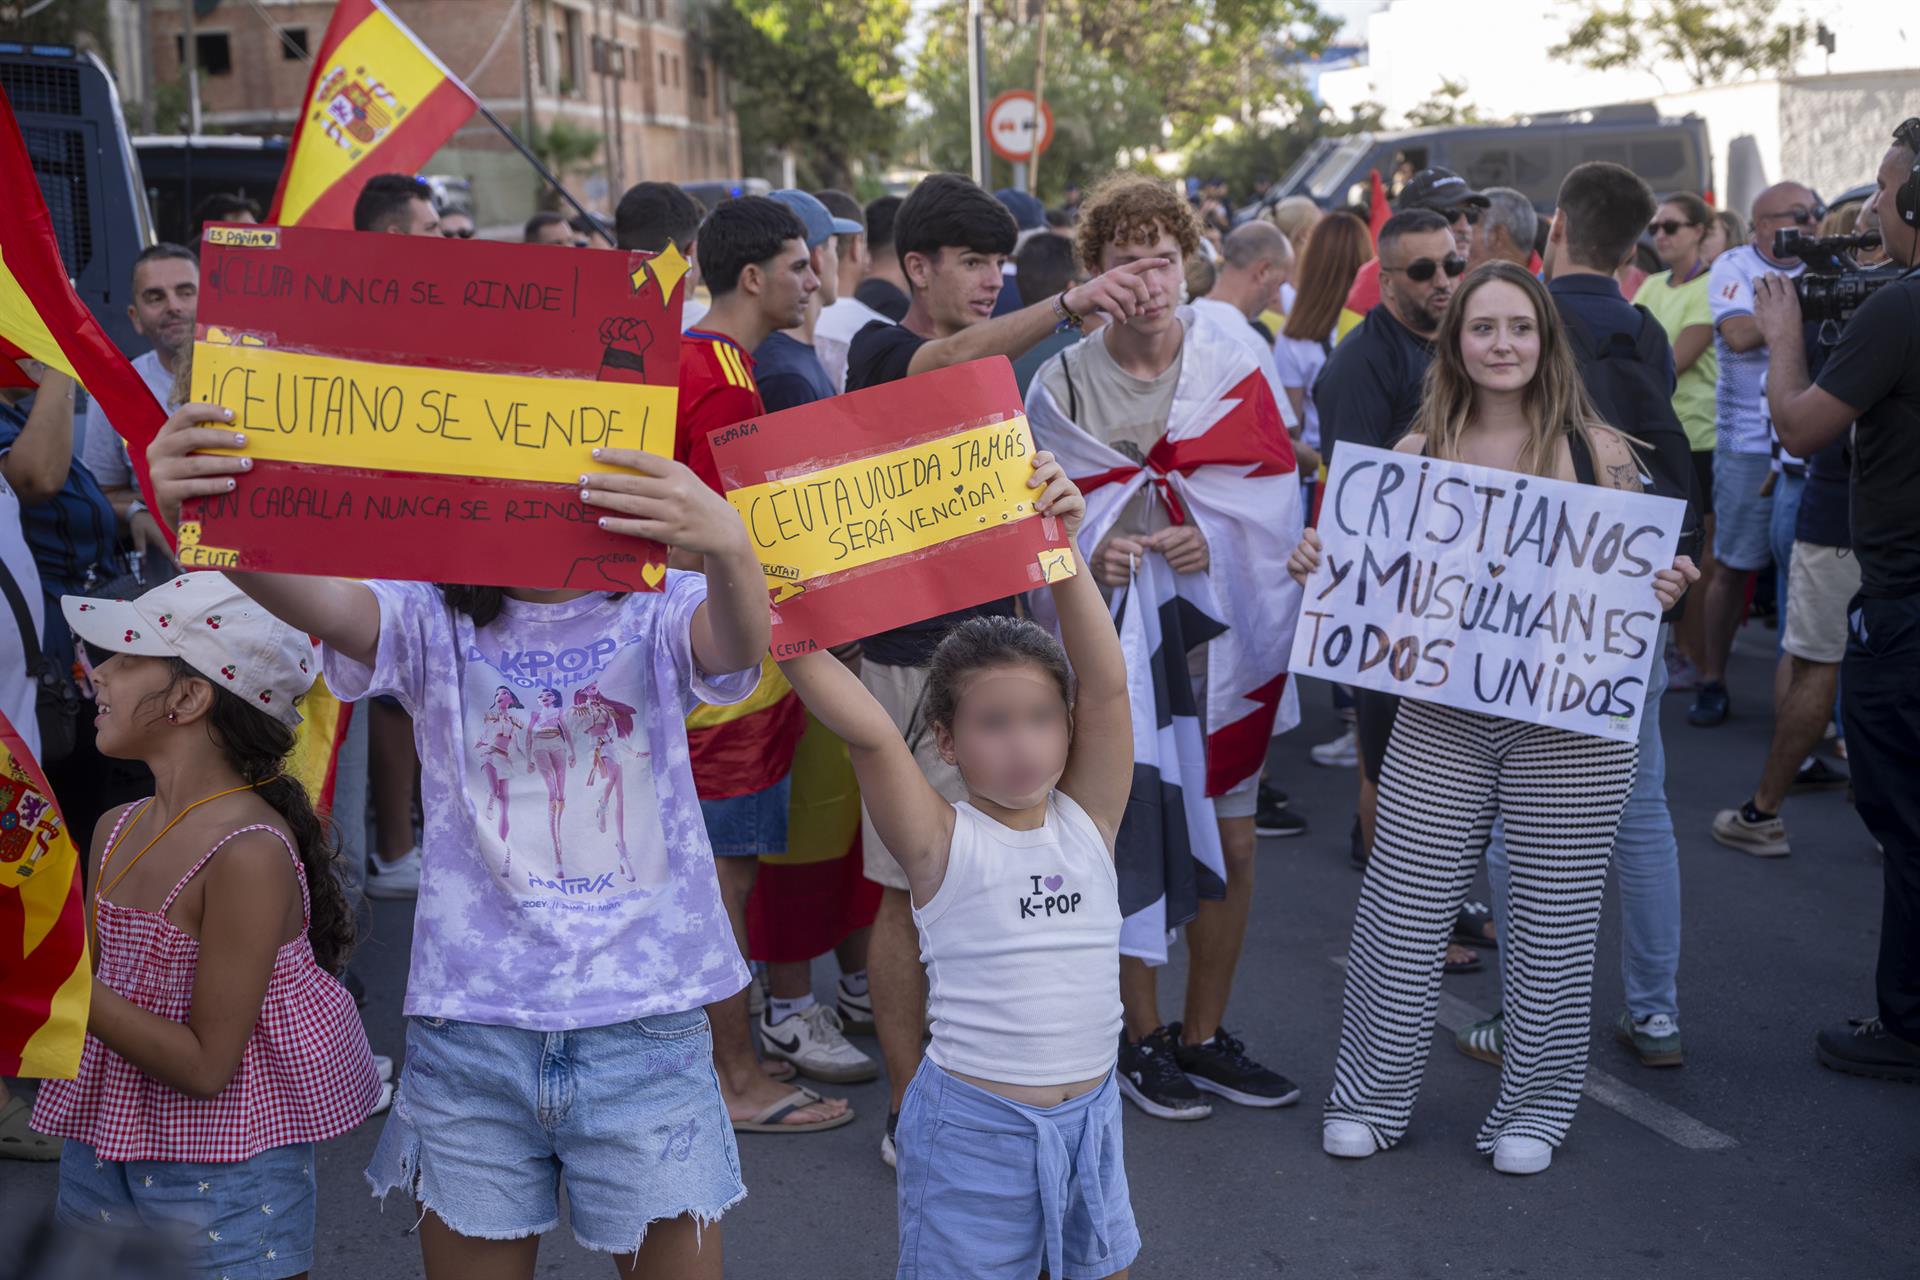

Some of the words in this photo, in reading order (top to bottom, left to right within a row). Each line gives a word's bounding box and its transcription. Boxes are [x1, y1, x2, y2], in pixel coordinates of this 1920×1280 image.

[304, 272, 400, 305] NUNCA
[409, 281, 445, 305] SE
[416, 390, 473, 441] SE
[713, 423, 760, 447] ESPAÑA
[854, 453, 942, 510] UNIDA
[950, 427, 1027, 477] JAMÁS
[250, 485, 353, 520] CABALLA
[364, 495, 451, 520] NUNCA
[459, 499, 493, 520] SE
[504, 499, 617, 525] RINDE
[828, 508, 895, 561] SERÁ
[1354, 543, 1656, 660] MUSULMANES
[500, 638, 617, 678] KPOP
[776, 639, 818, 657] CEUTA
[1304, 610, 1457, 688] TODOS
[1030, 875, 1043, 895] I
[1019, 892, 1082, 919] K-POP
